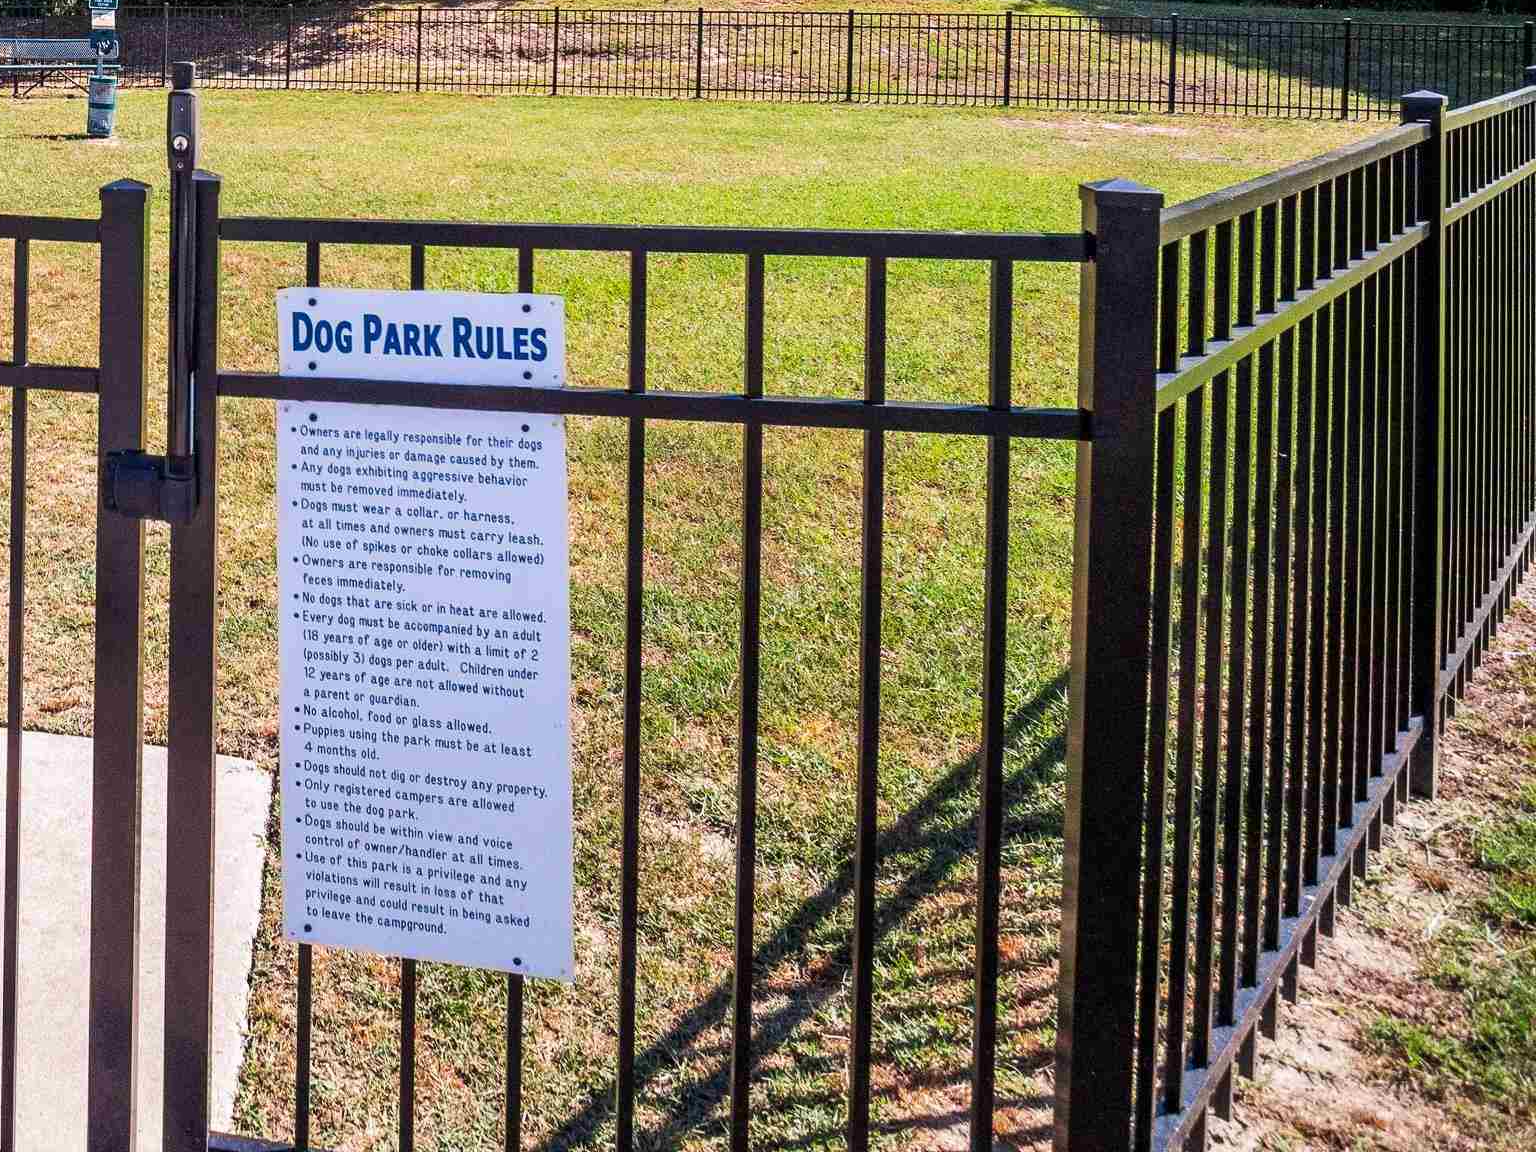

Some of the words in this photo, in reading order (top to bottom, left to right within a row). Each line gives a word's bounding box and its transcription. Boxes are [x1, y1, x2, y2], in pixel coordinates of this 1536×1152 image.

[300, 424, 339, 438] Owners
[343, 430, 360, 440] are
[364, 428, 399, 444] legally
[403, 432, 461, 447] responsible
[466, 434, 482, 446] for
[488, 435, 513, 448] their
[518, 437, 542, 452] dogs
[300, 443, 318, 456] and
[322, 447, 342, 459] any
[346, 445, 385, 461] injuries
[387, 451, 400, 460] or
[404, 449, 445, 466] damage
[450, 454, 486, 466] caused
[490, 455, 503, 470] by
[509, 455, 538, 469] them.
[301, 460, 322, 476] Any
[327, 462, 351, 477] dogs
[355, 465, 407, 481] exhibiting
[412, 470, 473, 483] aggressive
[478, 471, 527, 487] behavior
[300, 481, 326, 493] must
[330, 481, 342, 493] be
[347, 484, 392, 497] removed
[397, 486, 466, 504] immediately.
[302, 553, 344, 568] Owners
[348, 560, 367, 570] are
[369, 561, 432, 575] responsible
[438, 564, 455, 576] for
[460, 568, 510, 584] removing
[303, 572, 334, 586] feces
[336, 575, 405, 594] immediately.
[302, 591, 315, 604] No
[319, 592, 342, 608] dogs
[346, 594, 369, 608] that
[374, 599, 392, 610] are
[396, 599, 417, 612] sick
[422, 603, 432, 613] or
[436, 601, 445, 615] in
[449, 603, 474, 617] heat
[478, 608, 497, 619] are
[502, 608, 546, 623] allowed.
[302, 609, 333, 626] Every
[338, 612, 354, 629] dog
[358, 616, 384, 628] must
[388, 616, 399, 630] be
[404, 621, 472, 636] accompanied
[476, 624, 489, 640] by
[494, 629, 508, 639] an
[512, 628, 540, 642] adult
[323, 633, 353, 645] years
[356, 633, 369, 646] of
[374, 637, 392, 650] age
[397, 639, 408, 649] or
[412, 638, 442, 652] older)
[447, 641, 470, 655] with
[474, 646, 481, 656] a
[486, 644, 509, 659] limit
[514, 648, 526, 660] of
[530, 648, 538, 662] 2
[304, 666, 317, 679] 12
[320, 670, 350, 682] years
[354, 671, 366, 683] of
[370, 675, 392, 687] age
[394, 677, 412, 688] are
[416, 679, 434, 690] not
[438, 679, 478, 694] allowed
[482, 683, 524, 699] without
[304, 688, 310, 697] a
[314, 688, 349, 701] parent
[354, 692, 364, 703] or
[369, 693, 419, 708] guardian.
[304, 703, 318, 717] No
[368, 710, 391, 724] food
[396, 715, 407, 726] or
[410, 714, 441, 729] glass
[446, 718, 491, 734] allowed.
[303, 722, 346, 738] Puppies
[349, 727, 376, 742] using
[382, 729, 399, 744] the
[404, 734, 432, 747] park
[434, 738, 462, 750] must
[466, 739, 478, 752] be
[483, 743, 496, 754] at
[501, 743, 531, 757] least
[304, 741, 312, 753] 4
[315, 743, 356, 758] months
[361, 747, 379, 760] old.
[304, 759, 329, 774] Dogs
[333, 763, 365, 778] should
[369, 768, 386, 780] not
[390, 769, 405, 782] dig
[409, 773, 420, 783] or
[424, 772, 466, 789] destroy
[471, 780, 492, 792] any
[496, 783, 547, 798] property.
[304, 777, 329, 792] Only
[334, 783, 390, 799] registered
[395, 790, 443, 805] campers
[448, 796, 467, 807] are
[472, 796, 514, 813] allowed
[305, 797, 316, 809] to
[320, 800, 338, 811] use
[344, 800, 361, 814] the
[366, 803, 384, 817] dog
[388, 807, 418, 821] park.
[304, 812, 331, 829] Dogs
[336, 818, 368, 833] should
[373, 822, 385, 835] be
[390, 824, 423, 840] within
[426, 829, 452, 843] view
[456, 834, 478, 846] and
[482, 836, 512, 850] voice
[305, 831, 343, 848] control
[347, 838, 360, 849] of
[364, 842, 447, 861] owner/handler
[452, 852, 464, 863] at
[469, 852, 482, 865] all
[488, 855, 522, 870] times.
[305, 846, 325, 864] Use
[330, 854, 343, 866] of
[347, 856, 367, 869] this
[372, 861, 397, 873] park
[402, 863, 411, 875] is
[416, 867, 422, 877] a
[428, 866, 475, 884] privilege
[480, 873, 500, 886] and
[505, 878, 526, 891] any
[306, 869, 359, 886] violations
[362, 876, 379, 888] will
[384, 880, 416, 894] result
[421, 882, 430, 896] in
[434, 884, 456, 899] loss
[460, 888, 473, 901] of
[479, 891, 503, 905] that
[305, 887, 351, 905] privilege
[354, 895, 375, 907] and
[377, 897, 407, 912] could
[411, 903, 444, 916] result
[449, 905, 458, 918] in
[462, 906, 490, 924] being
[496, 913, 529, 928] asked
[307, 904, 320, 917] to
[322, 906, 351, 921] leave
[356, 911, 372, 925] the
[376, 917, 446, 934] campground.
